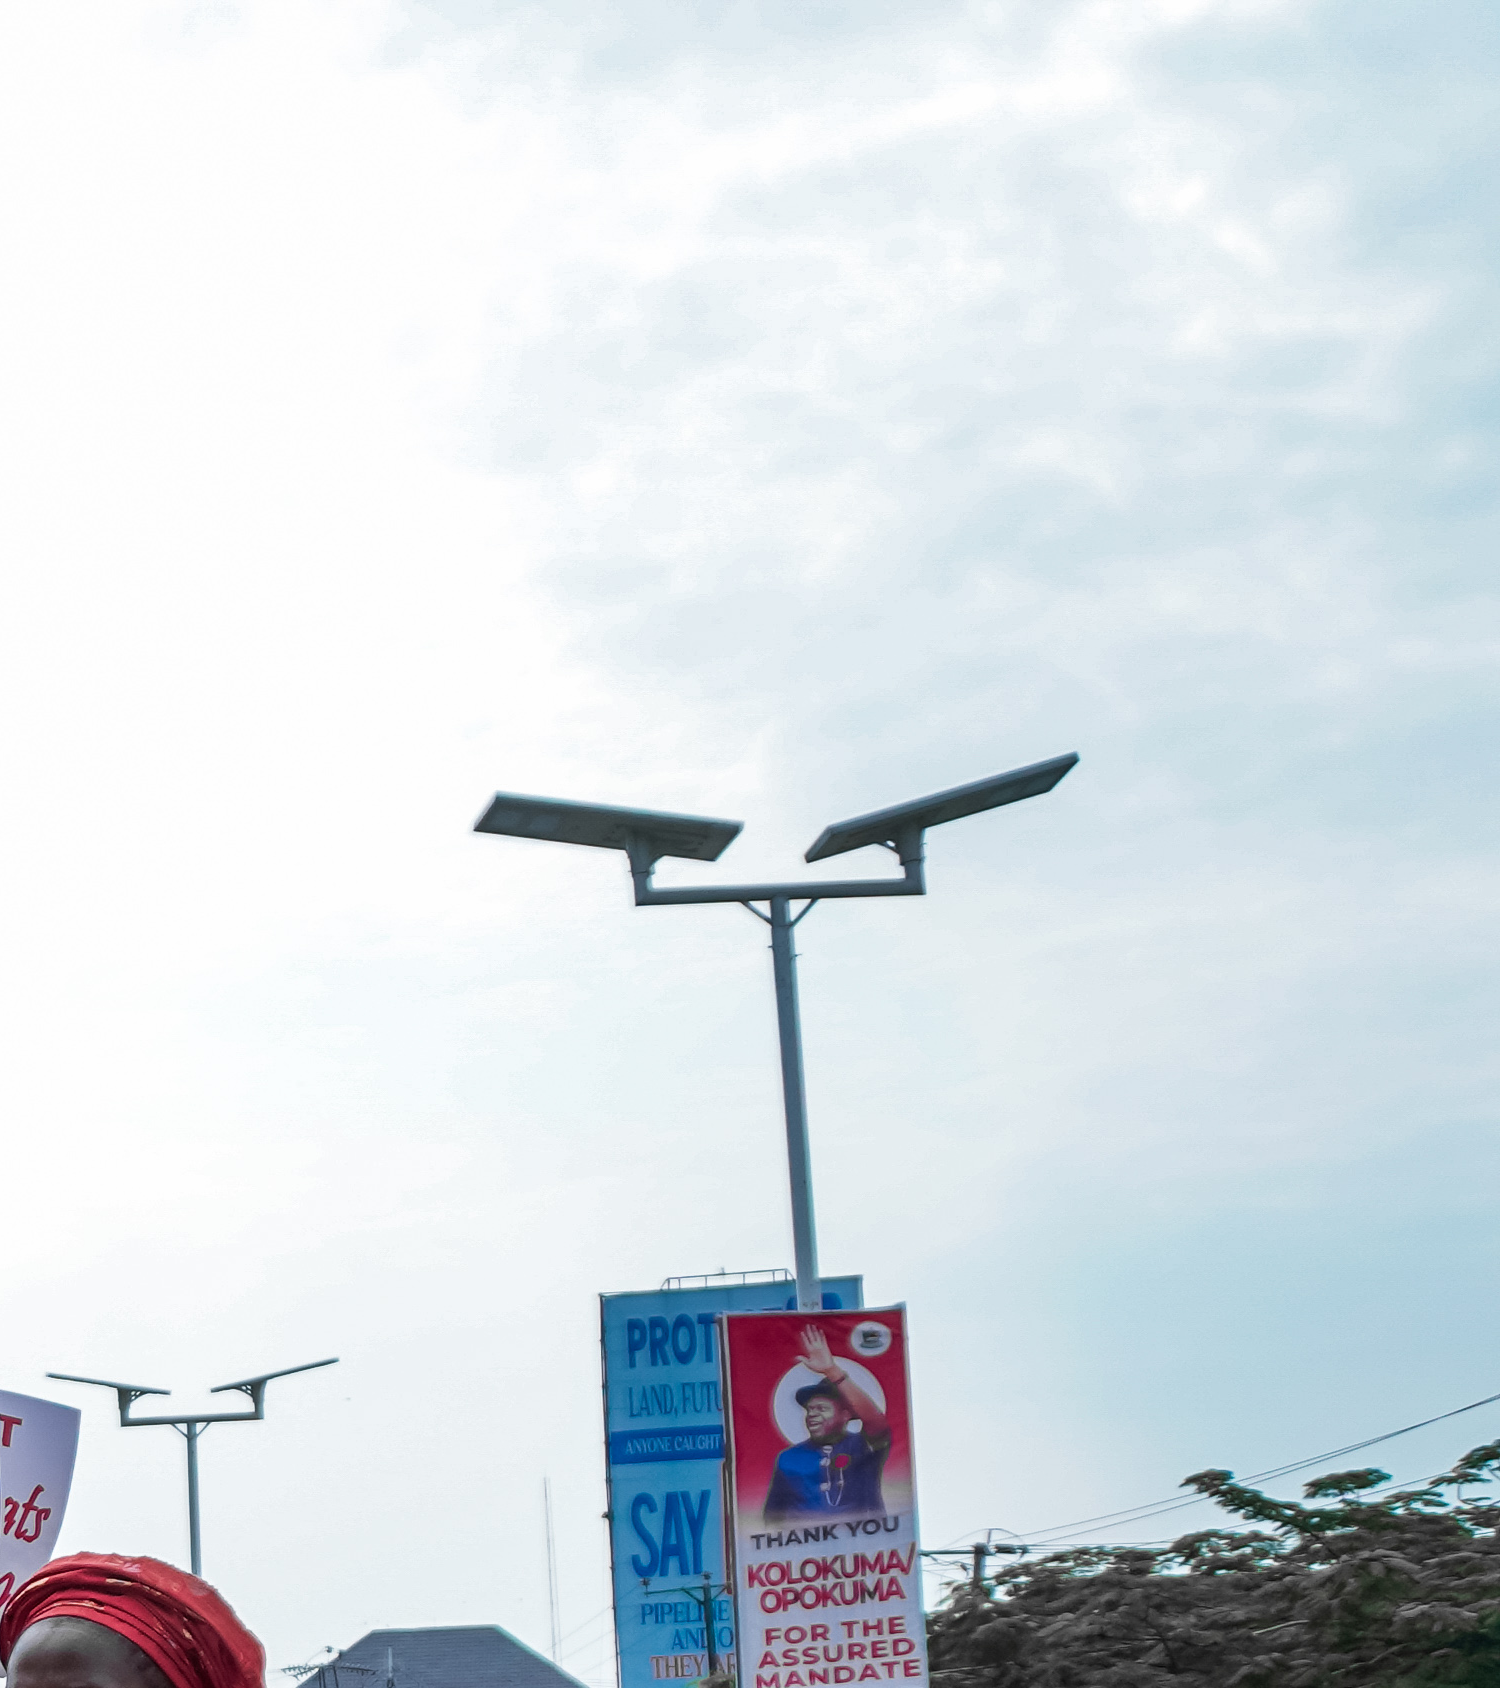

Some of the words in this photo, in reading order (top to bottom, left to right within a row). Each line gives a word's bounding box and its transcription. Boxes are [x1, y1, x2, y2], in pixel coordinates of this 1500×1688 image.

[627, 1312, 716, 1369] PROT
[629, 1384, 678, 1418] LAND,
[682, 1381, 722, 1414] FUTU
[626, 1436, 671, 1454] ANYONE
[674, 1433, 720, 1450] CAUGHT
[630, 1489, 711, 1579] SAY
[751, 1523, 839, 1550] THANK
[844, 1516, 899, 1537] YOU
[747, 1541, 916, 1588] KOLOKUMA/
[760, 1576, 906, 1614] OPOKUMA
[765, 1624, 830, 1646] FOR
[841, 1616, 905, 1638] THE
[650, 1654, 705, 1678] THEY
[758, 1638, 916, 1669] ASSURED
